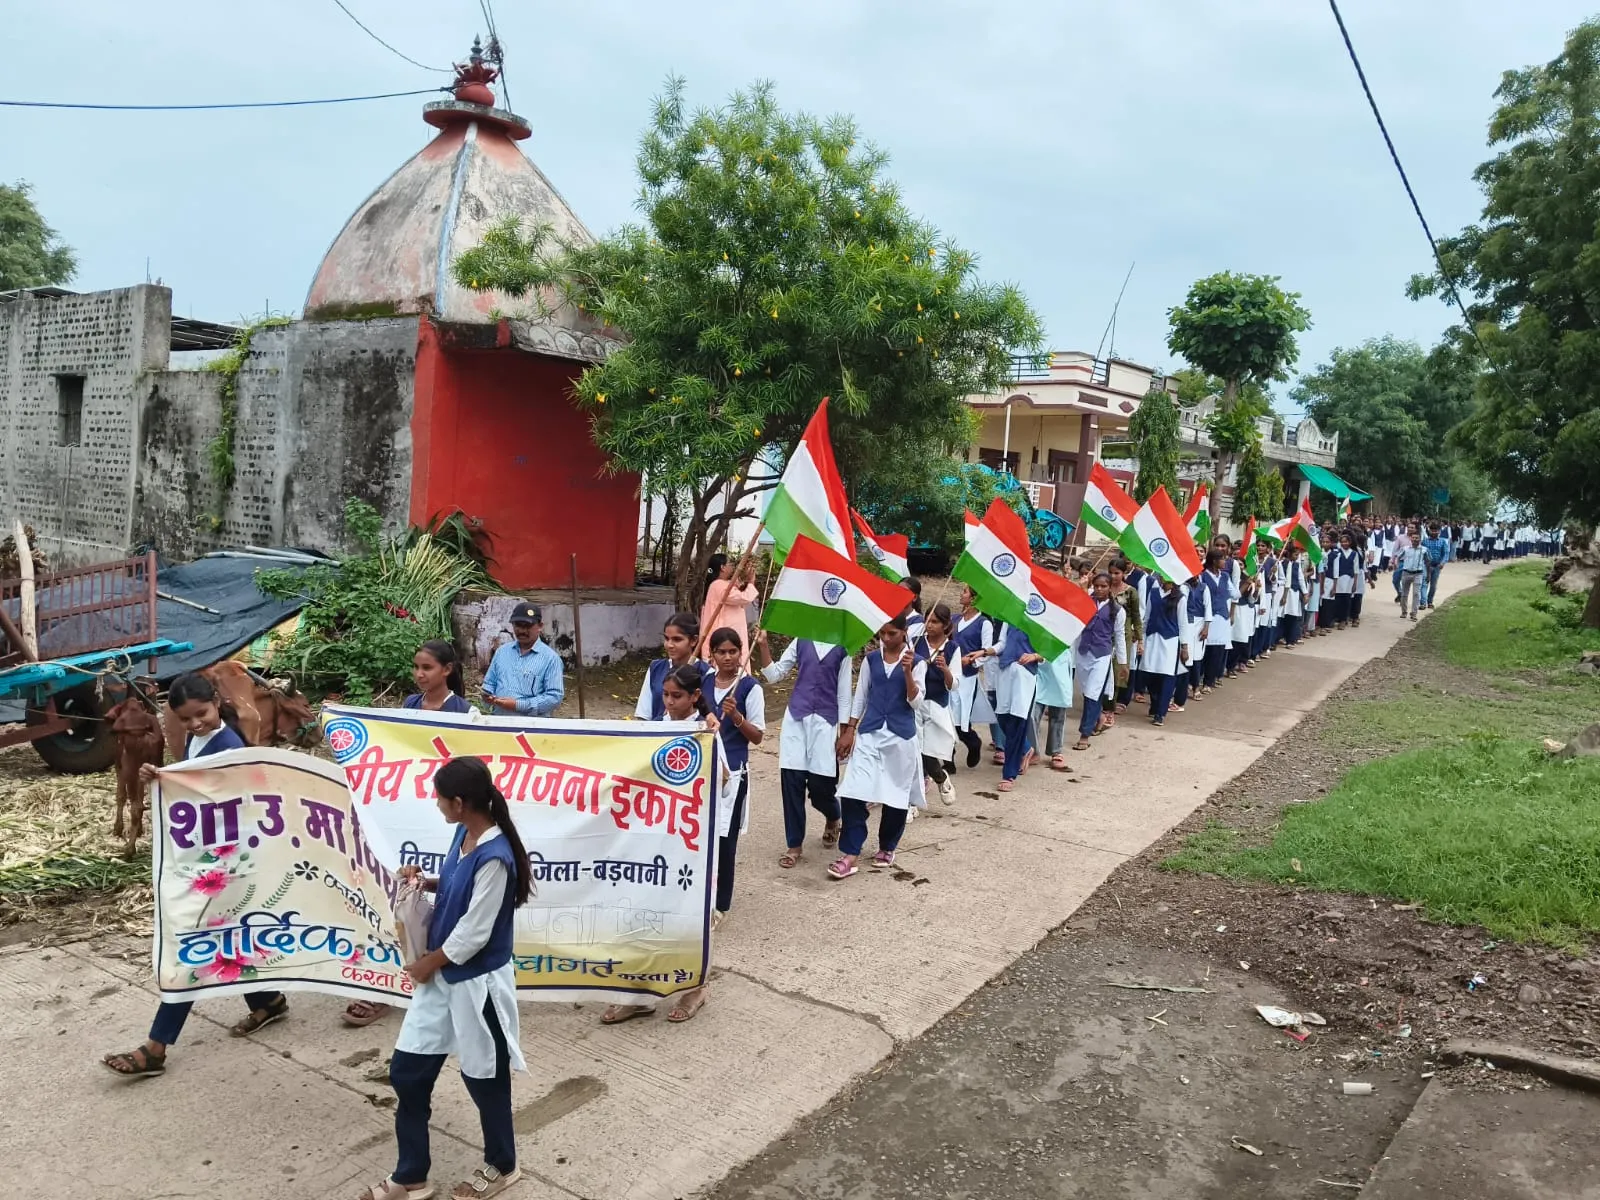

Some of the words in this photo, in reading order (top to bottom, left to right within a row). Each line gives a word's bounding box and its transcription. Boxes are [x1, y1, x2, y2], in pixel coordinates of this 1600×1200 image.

[494, 734, 605, 815] योजना
[610, 774, 705, 851] इकाई
[399, 841, 447, 875] विद्या
[175, 911, 356, 966] हार्दिक
[340, 965, 397, 989] करता
[514, 952, 623, 978] वागत
[617, 971, 669, 983] करता
